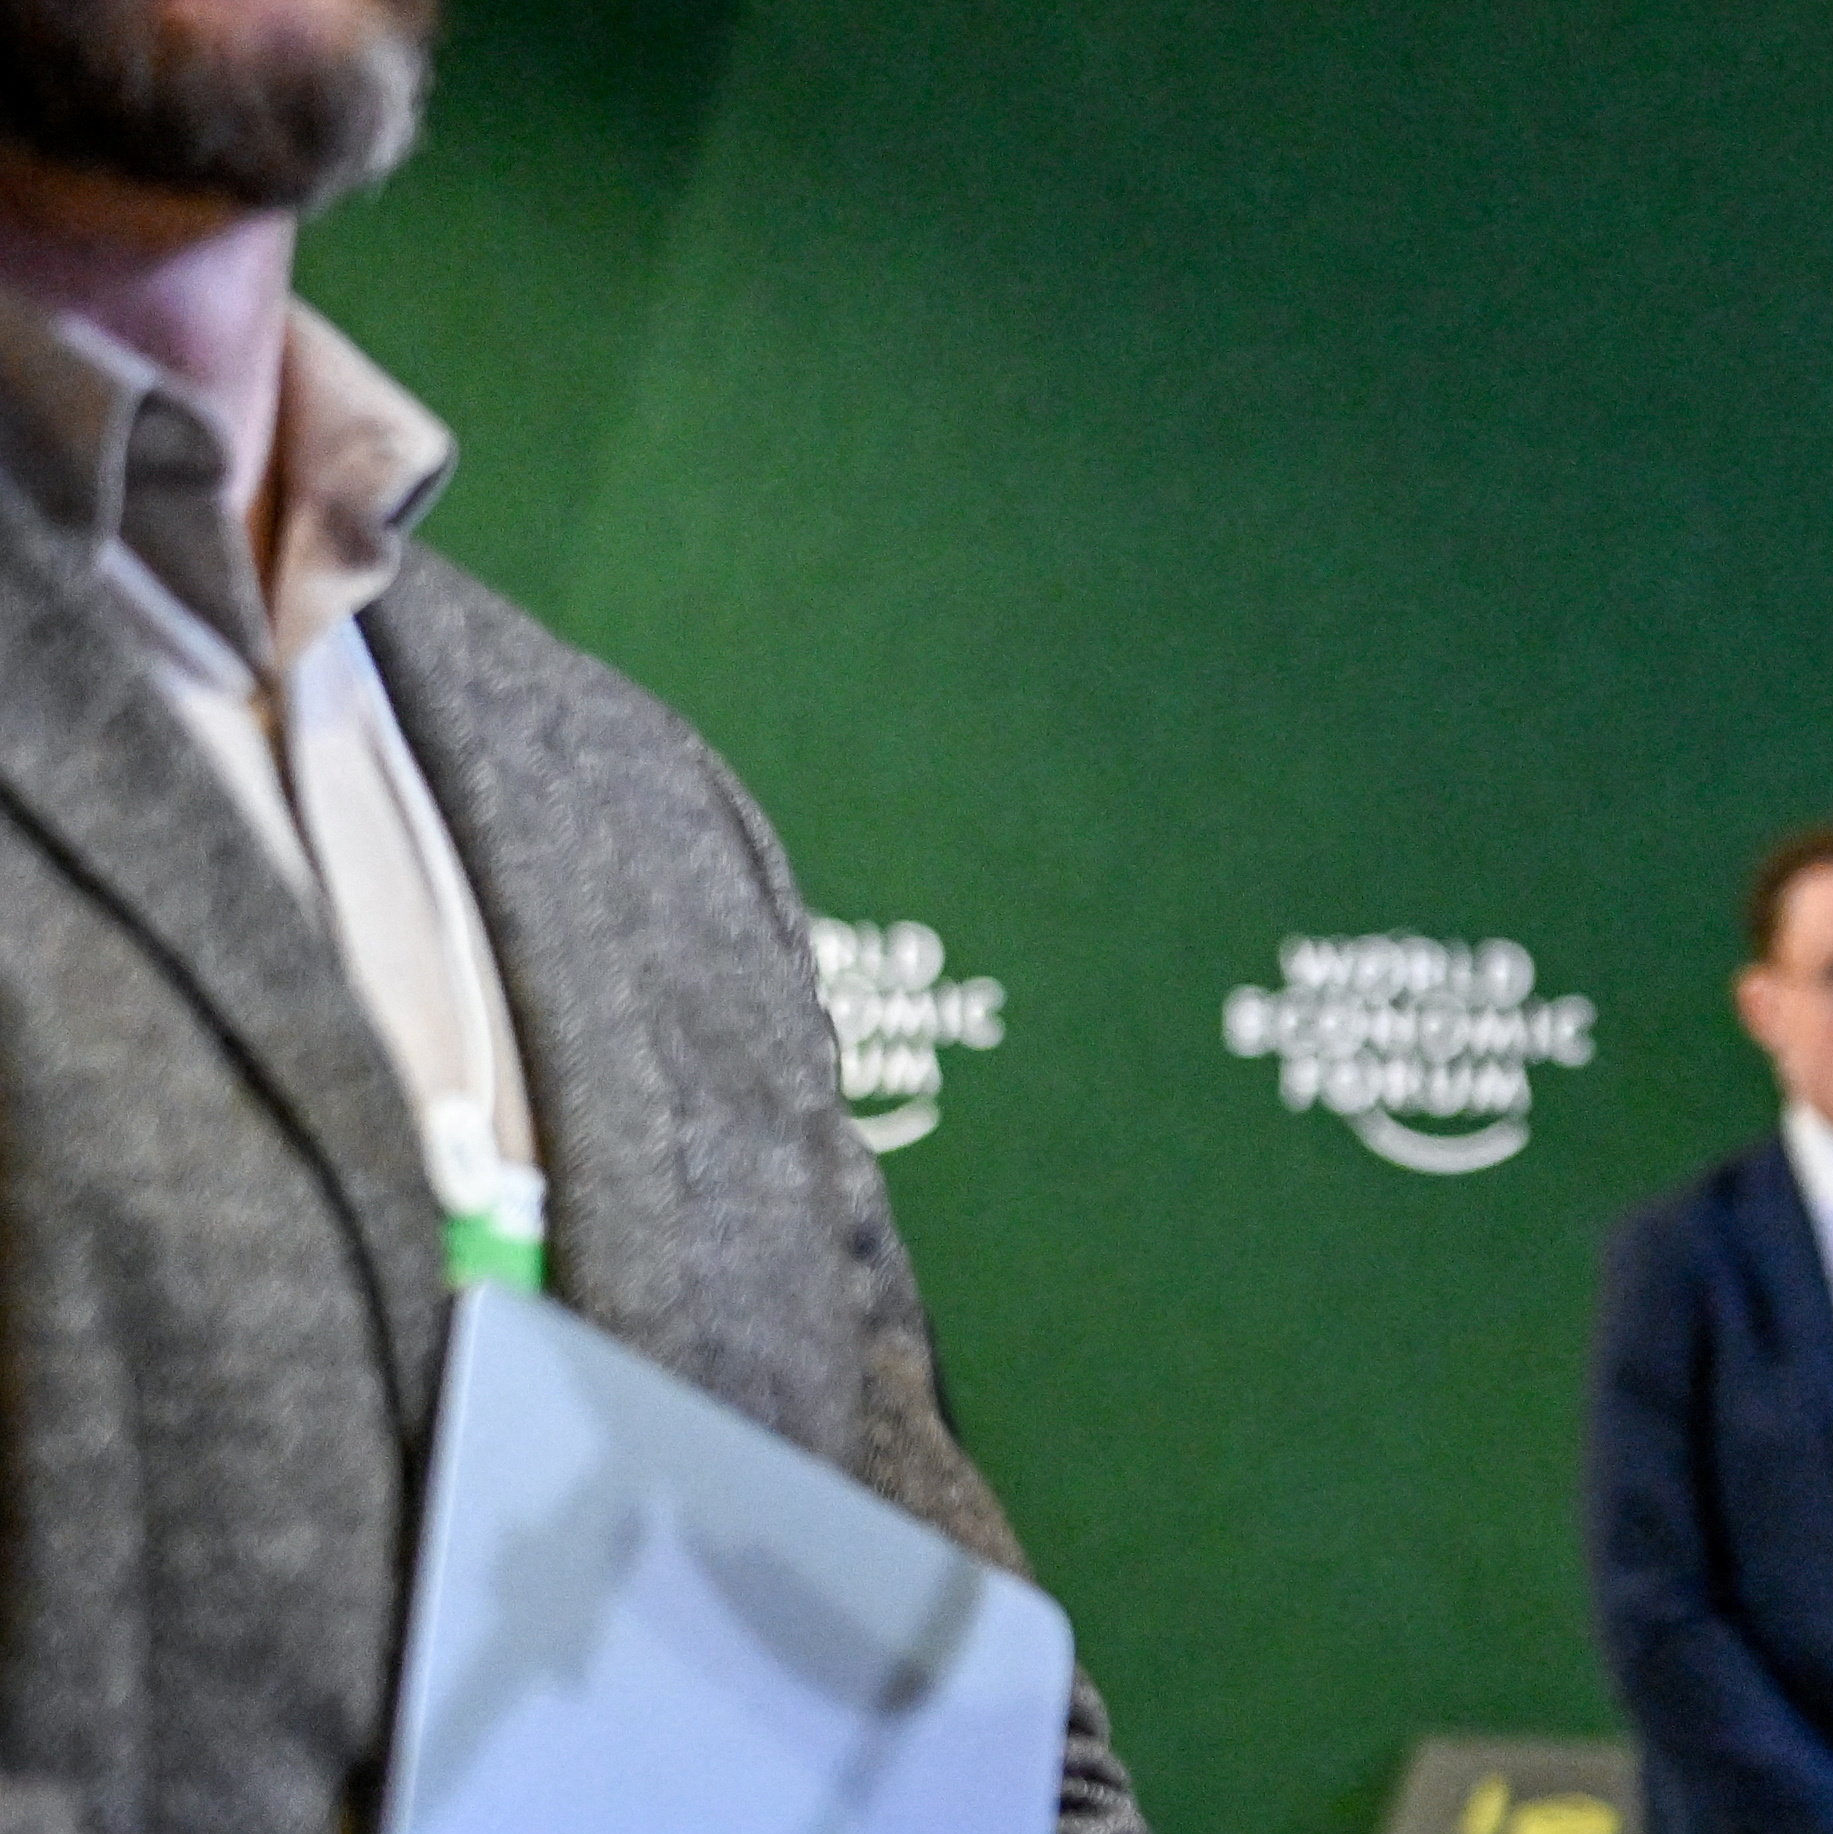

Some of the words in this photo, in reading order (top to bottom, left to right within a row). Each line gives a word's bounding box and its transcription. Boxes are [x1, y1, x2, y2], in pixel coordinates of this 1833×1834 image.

[1281, 934, 1535, 1008] WORLD
[1223, 984, 1598, 1067] ECONOMIC
[1281, 1053, 1531, 1115] FORUM
